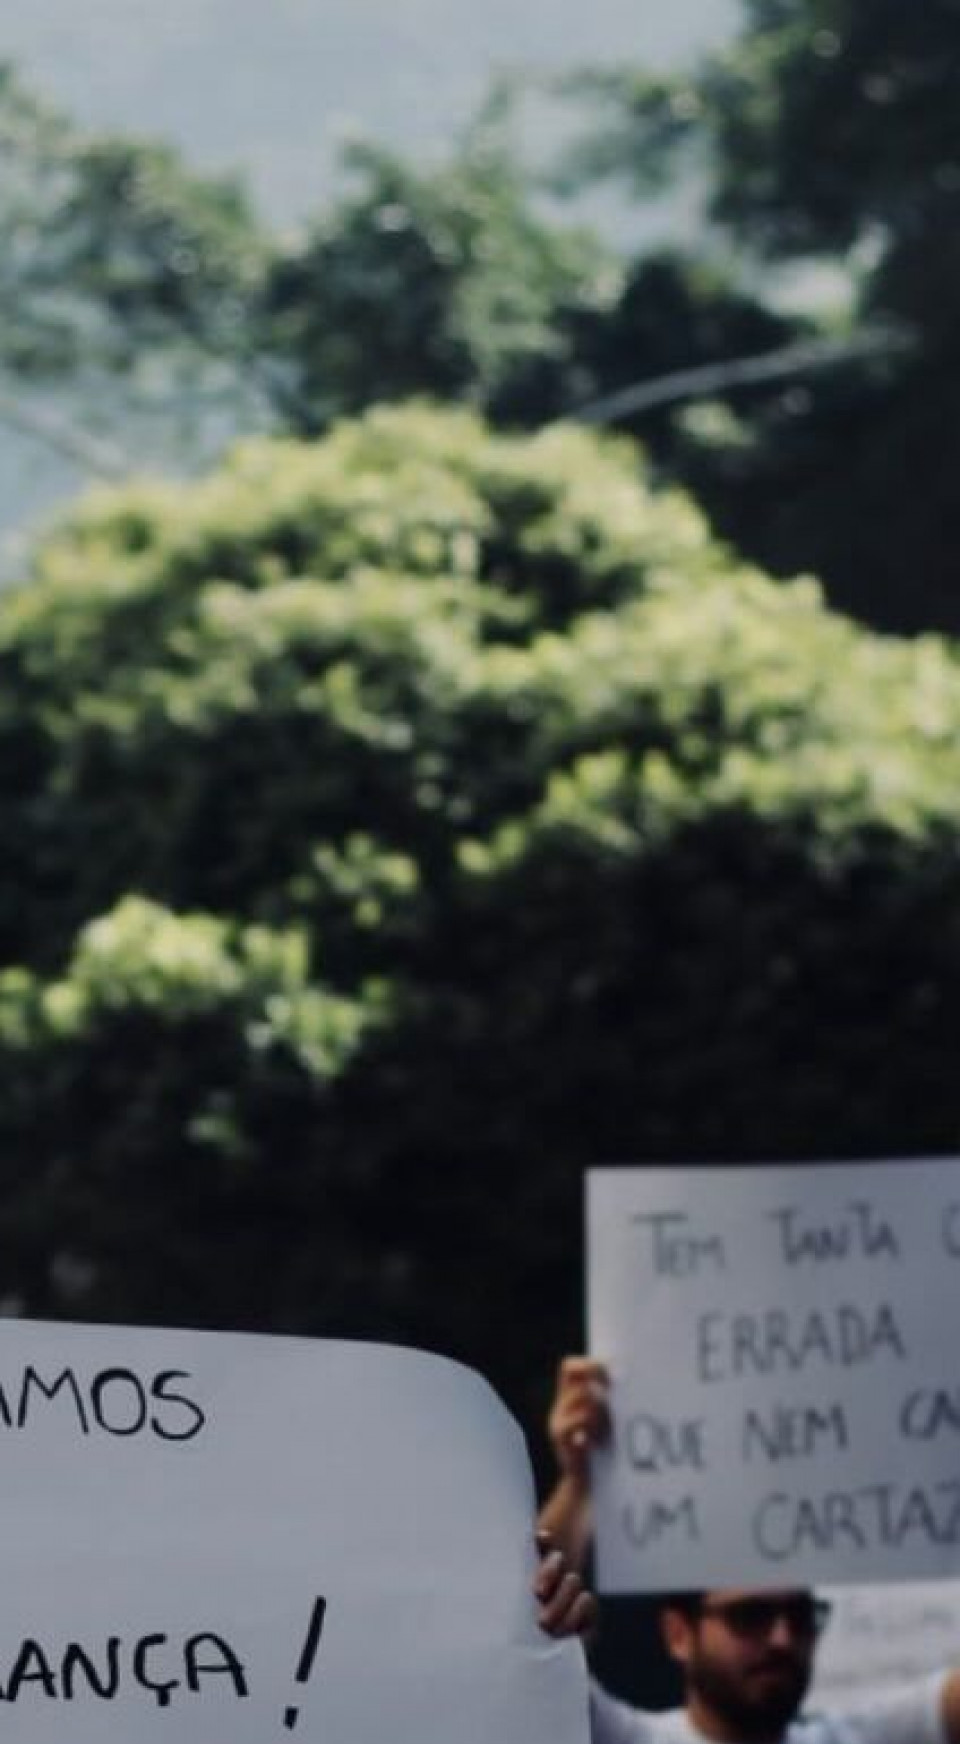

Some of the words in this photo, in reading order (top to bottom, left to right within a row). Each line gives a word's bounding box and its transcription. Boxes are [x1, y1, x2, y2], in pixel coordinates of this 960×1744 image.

[696, 1304, 906, 1383] ERRADA
[627, 1415, 706, 1474] QUE
[743, 1404, 848, 1463] NEM
[622, 1495, 700, 1548] UM
